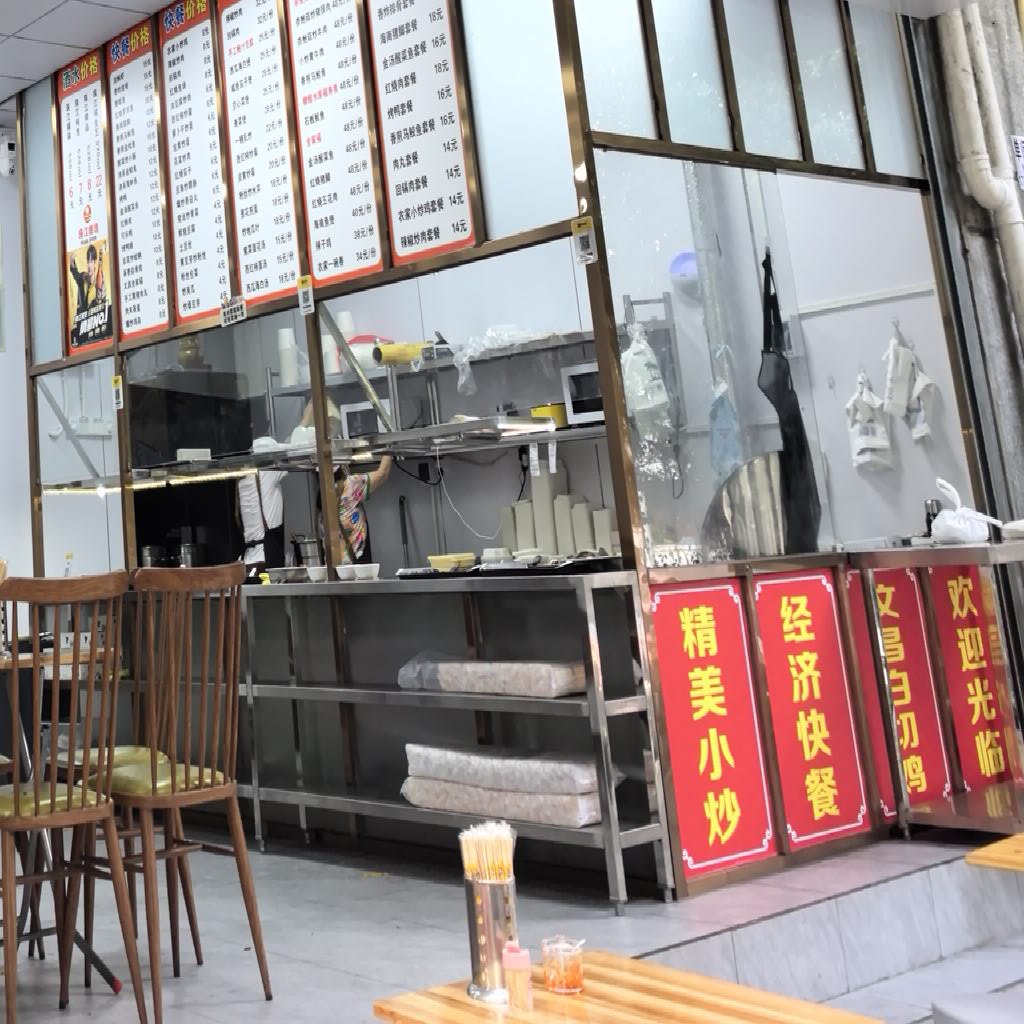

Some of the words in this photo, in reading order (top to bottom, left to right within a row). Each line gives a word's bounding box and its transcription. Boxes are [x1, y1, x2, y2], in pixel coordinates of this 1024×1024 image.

[428, 6, 443, 24] 18元
[431, 31, 446, 50] 16元
[433, 57, 449, 76] 18元
[437, 83, 452, 102] 16元
[439, 110, 455, 128] 16元
[442, 137, 458, 154] 14元
[445, 163, 461, 181] 14元
[448, 190, 464, 208] 14元
[451, 218, 467, 235] 14元
[946, 575, 1006, 778] 欢迎光临
[779, 595, 840, 821] 经济快餐
[679, 604, 742, 846] 精美小炒
